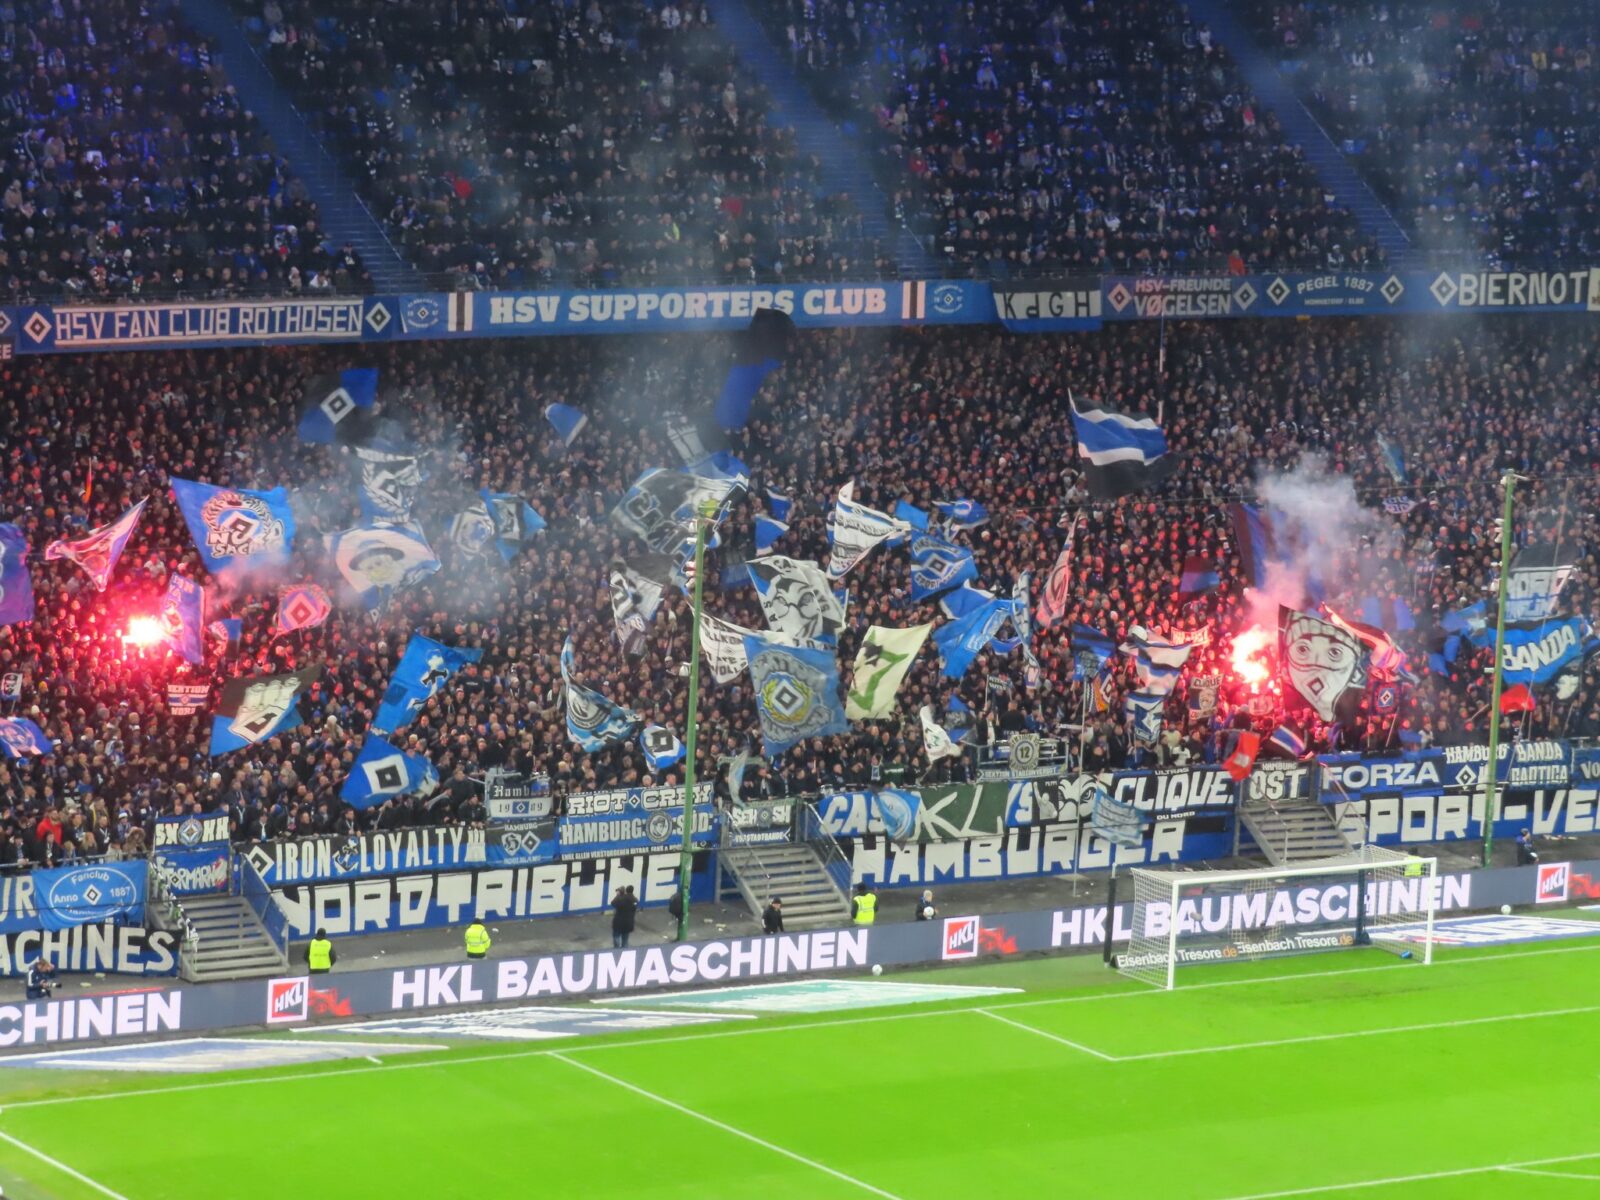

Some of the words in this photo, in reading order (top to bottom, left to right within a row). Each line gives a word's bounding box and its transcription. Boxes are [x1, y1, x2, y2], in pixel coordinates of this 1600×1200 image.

[1135, 278, 1231, 293] HSV-FREUNDE
[1297, 276, 1339, 294] PEGEL
[1344, 276, 1374, 292] 1887
[1458, 272, 1588, 305] BIERNOT
[490, 296, 561, 324] HSV
[568, 290, 794, 321] SUPPORTERS
[803, 287, 887, 316] CLUB
[56, 312, 104, 340] HSV
[114, 309, 160, 338] FAN
[169, 307, 230, 336] CLUB
[238, 304, 363, 334] ROTHOSEN
[1502, 624, 1576, 672] BANDA
[1020, 747, 1030, 759] 12
[1262, 761, 1297, 771] HAMBURG
[1516, 741, 1563, 762] BANDA
[1154, 767, 1189, 776] ULTRAS
[1250, 769, 1307, 800] OST
[1322, 761, 1440, 790] FORZA
[1581, 762, 1600, 780] VO
[567, 792, 628, 815] RIOT
[642, 785, 712, 809] CREW
[1335, 790, 1600, 846] SPORT-VE
[275, 839, 331, 881] IRON
[359, 827, 463, 873] LOYALTY
[71, 871, 110, 885] Fanclub
[1542, 868, 1565, 892] HKL
[54, 894, 79, 903] Anno
[110, 886, 131, 898] 1887
[271, 852, 681, 935] NORDTRIBÜNE
[1052, 906, 1132, 947] HKL
[1144, 874, 1471, 938] BAUMASCHINEN
[947, 924, 976, 951] HKL
[392, 964, 483, 1008] HKL
[497, 929, 869, 999] BAUMASCHINEN
[1117, 951, 1178, 968] Eisenbach
[274, 983, 304, 1014] HKL
[0, 991, 182, 1046] CHINEN
